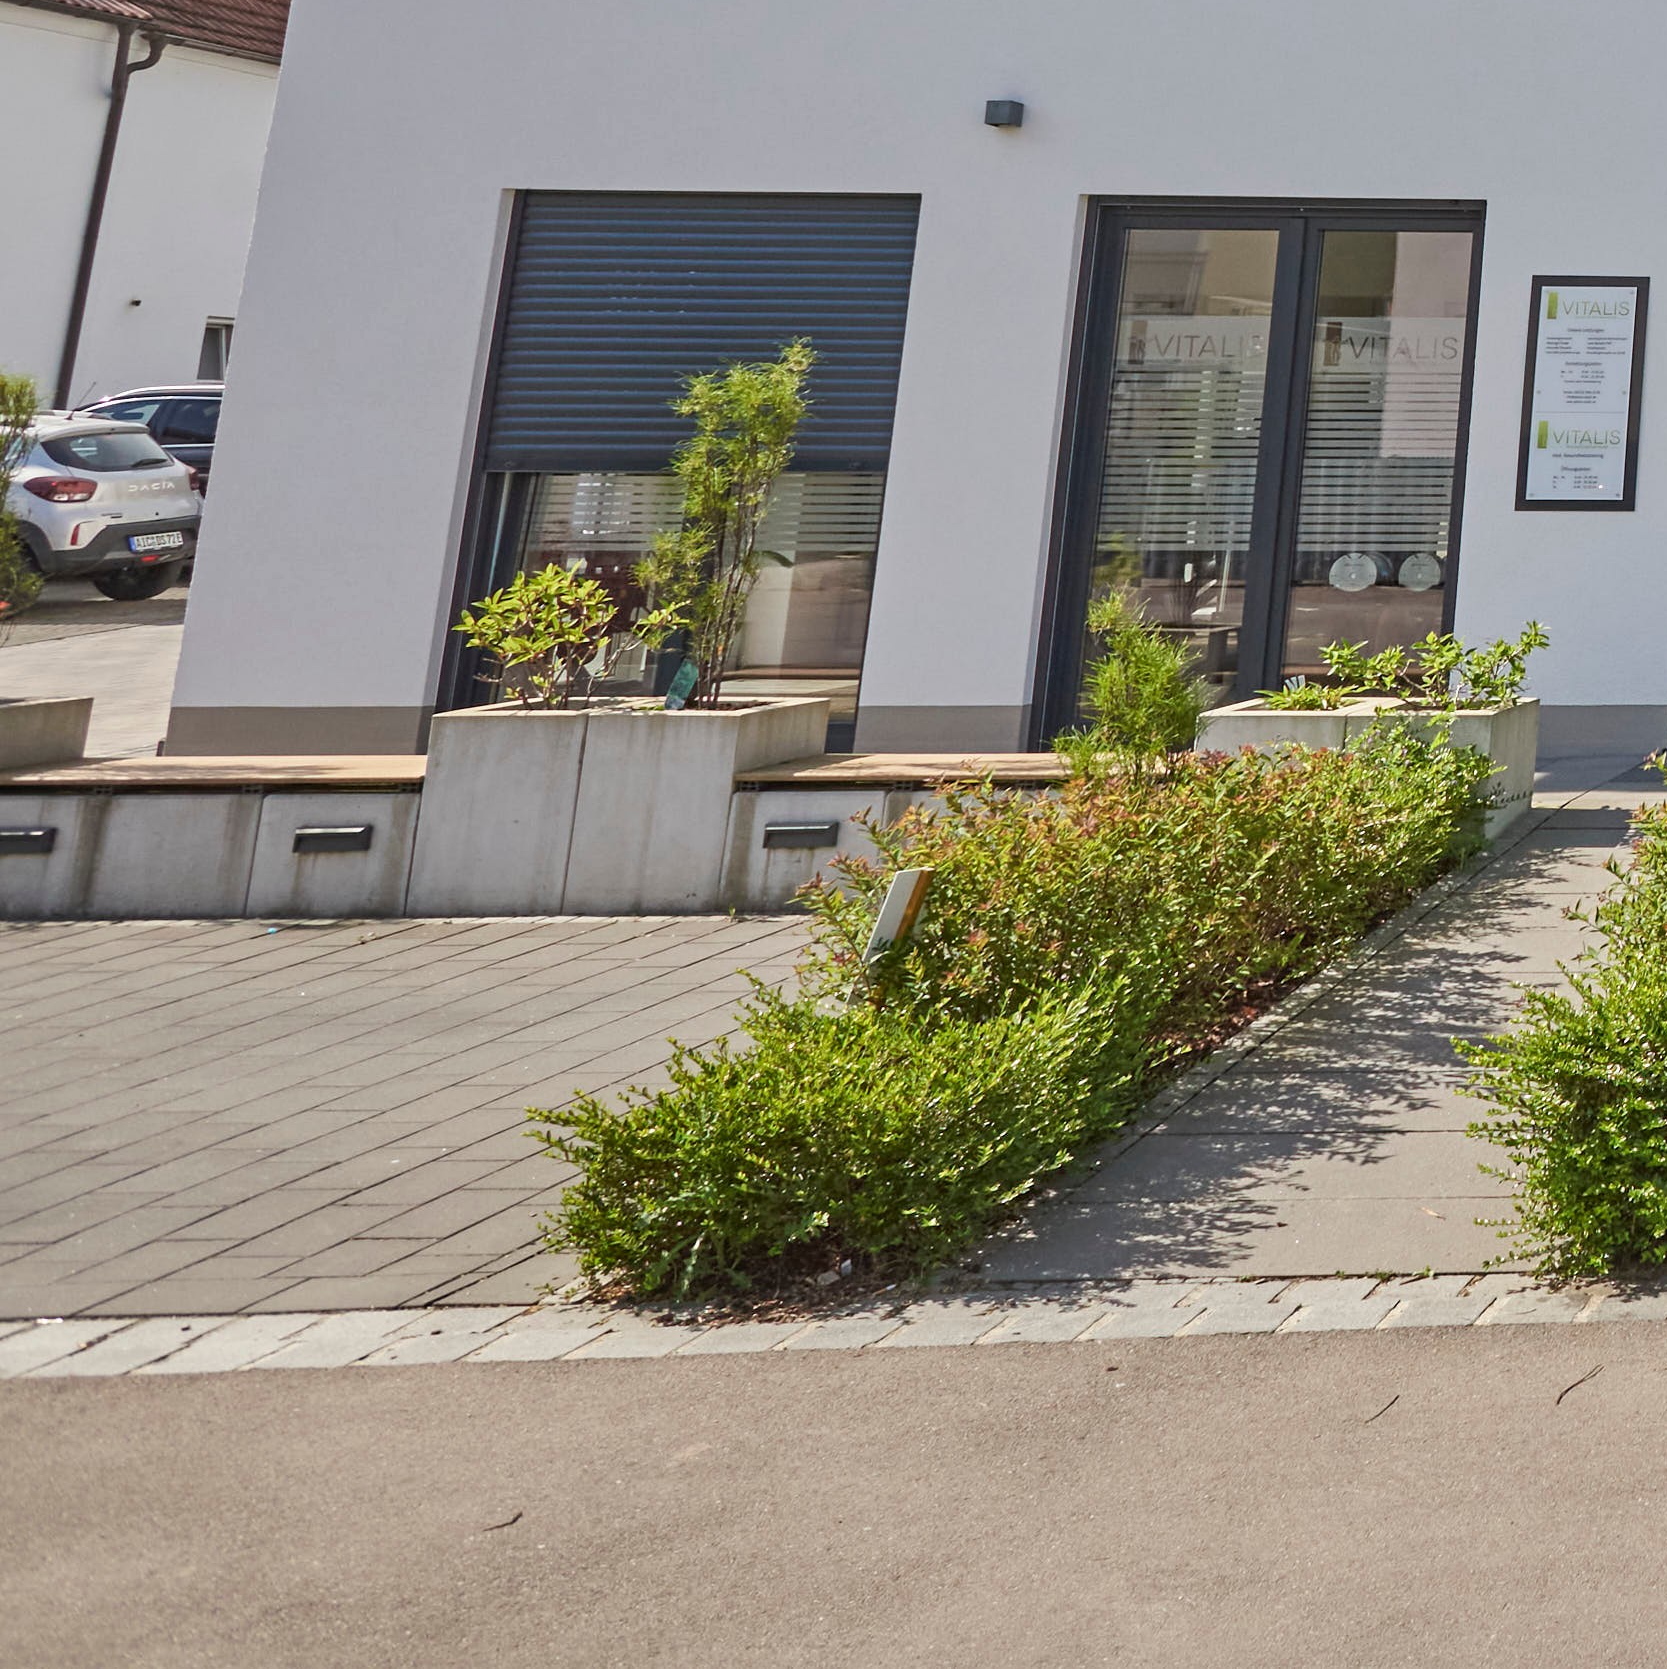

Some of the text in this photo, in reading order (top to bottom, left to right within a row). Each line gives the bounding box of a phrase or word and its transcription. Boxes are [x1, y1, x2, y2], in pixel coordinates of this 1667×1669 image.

[1562, 301, 1630, 316] VITALIS
[1349, 335, 1459, 360] VITALIS
[1552, 429, 1621, 445] VITALIS
